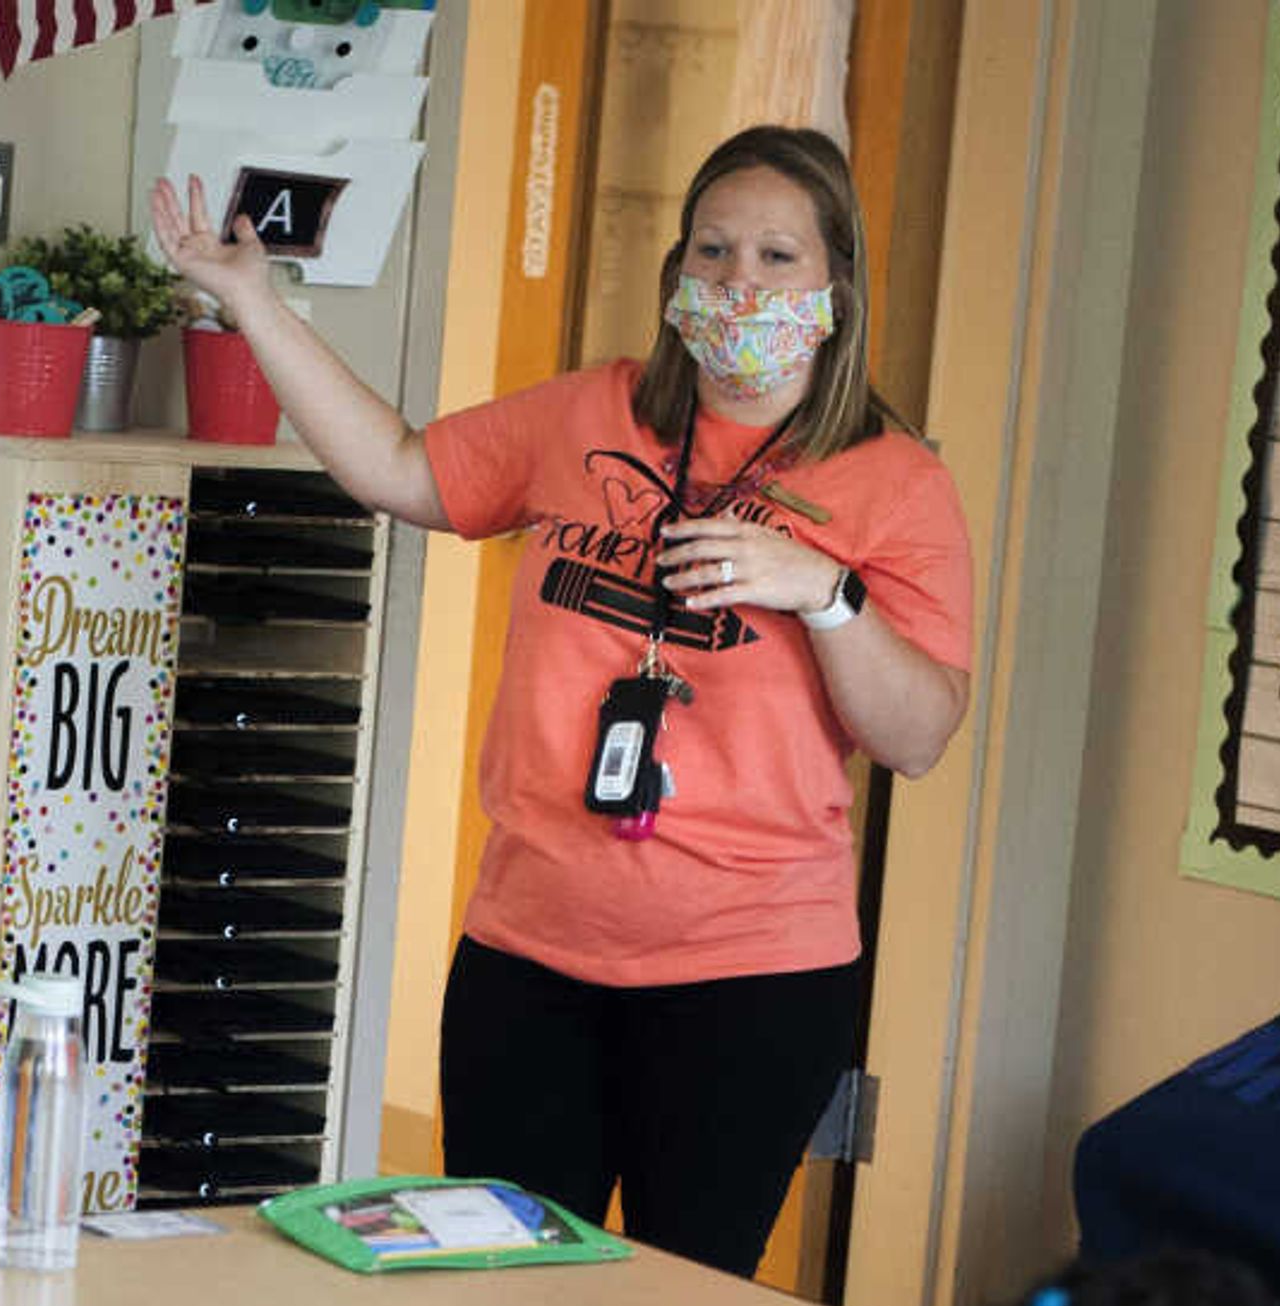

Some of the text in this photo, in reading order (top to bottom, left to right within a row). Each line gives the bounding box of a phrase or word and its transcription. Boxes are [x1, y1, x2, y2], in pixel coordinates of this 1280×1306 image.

[255, 188, 294, 235] A
[24, 575, 162, 667] Dream
[46, 659, 133, 792] BIG
[13, 844, 145, 949] Sparkle
